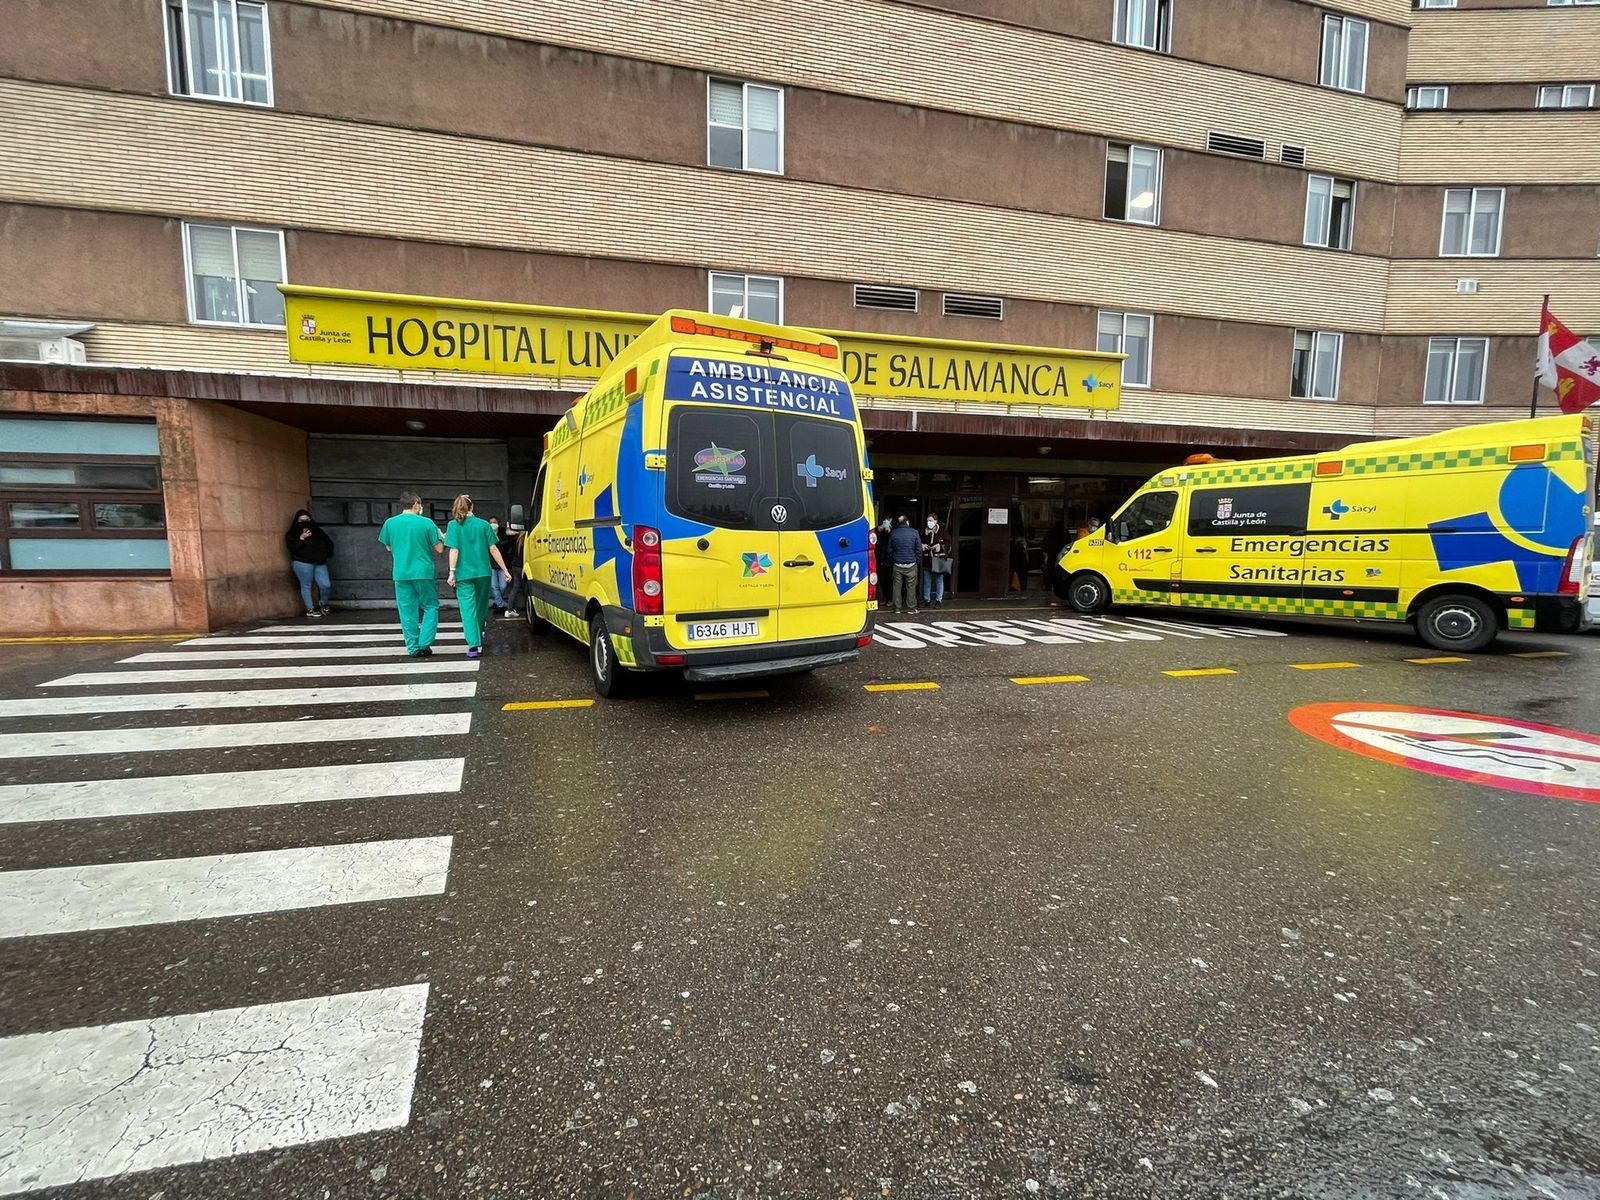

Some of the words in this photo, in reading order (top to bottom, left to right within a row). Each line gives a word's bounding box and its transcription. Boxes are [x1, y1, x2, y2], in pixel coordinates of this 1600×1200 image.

[299, 334, 326, 342] Castilla
[366, 316, 556, 365] HOSPITAL
[566, 329, 639, 368] UN
[842, 351, 878, 386] DE
[889, 354, 1069, 398] SALAMANCA
[689, 360, 840, 396] AMBULANCIA
[1098, 380, 1114, 390] Sacyl
[691, 381, 841, 416] ASISTENCIAL
[824, 465, 847, 481] Sacyl
[1232, 511, 1254, 519] Junta
[1351, 504, 1377, 515] Sacyl
[1212, 518, 1239, 526] Castilla
[1239, 519, 1245, 527] y
[1246, 518, 1267, 526] León
[547, 532, 588, 559] Emergencias
[1133, 549, 1152, 560] 112
[1230, 535, 1390, 557] Emergencias
[547, 565, 577, 591] Sanitarias
[832, 561, 861, 585] 112
[1230, 564, 1345, 582] Sanitarias
[696, 623, 728, 637] 6346
[732, 622, 756, 636] HJT
[873, 615, 1288, 649] URGENCIAS
